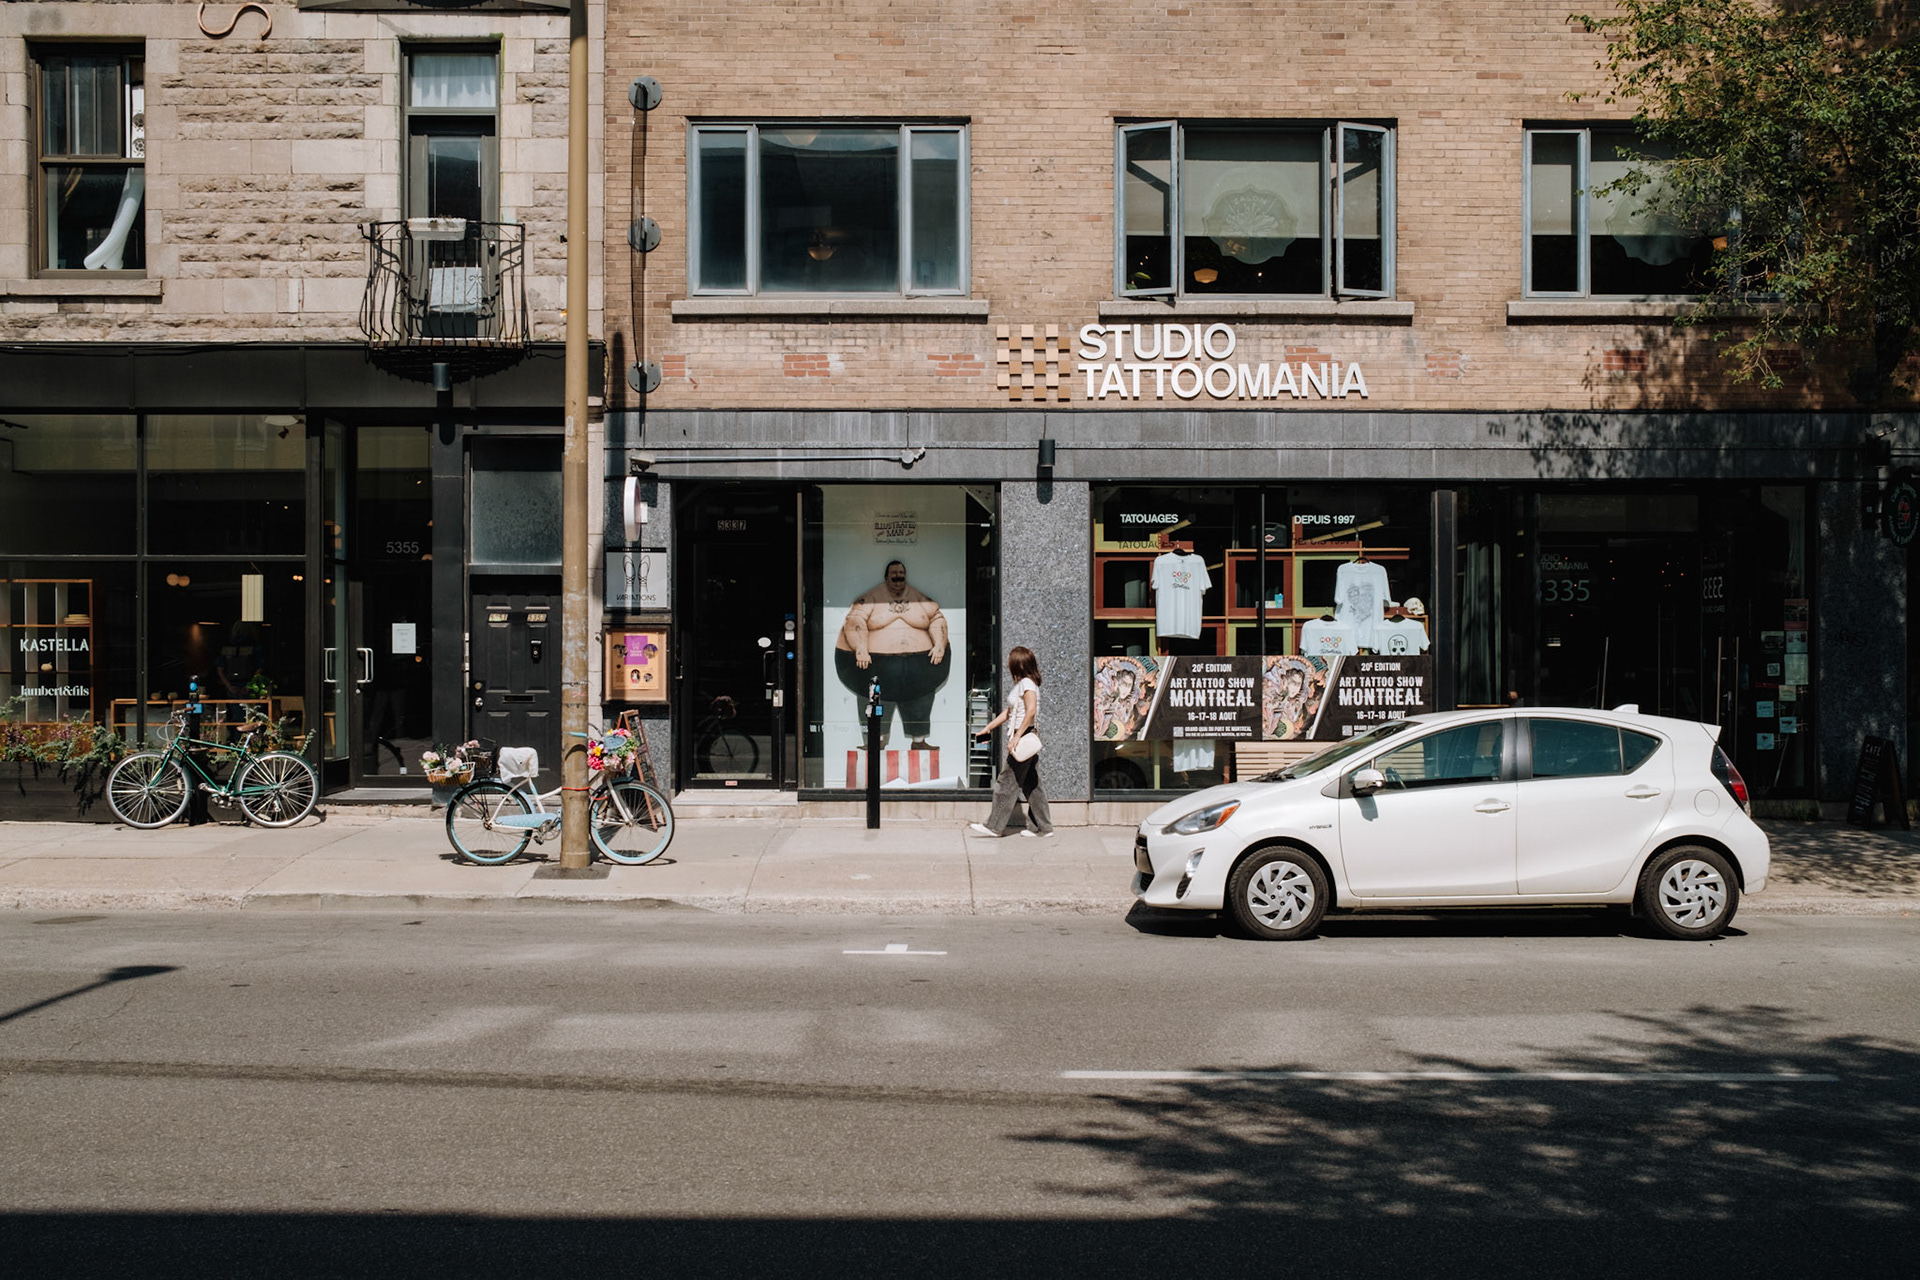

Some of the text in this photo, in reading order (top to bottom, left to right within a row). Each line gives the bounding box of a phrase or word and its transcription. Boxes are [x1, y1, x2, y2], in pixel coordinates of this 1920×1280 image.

[1078, 323, 1237, 360] STUDIO
[1077, 362, 1369, 399] TATTOOMANIA
[1120, 514, 1179, 524] TATOUAGES
[1294, 515, 1356, 525] DEPUIS 1997
[386, 541, 419, 554] 5355
[1541, 562, 1589, 570] TOOMANIA
[1544, 579, 1590, 602] 335
[20, 638, 89, 652] KASTELLA
[1205, 664, 1232, 673] EDITION
[1374, 662, 1401, 672] EDITION
[1170, 678, 1255, 688] ART TATTOO SHOW
[1339, 677, 1424, 687] ART TATTOO SHOW
[21, 685, 89, 697] lambert&fils
[1169, 689, 1256, 707] MONTREAL
[1338, 688, 1424, 706] MONTREAL
[1187, 712, 1237, 720] 16-17-18 AOUT
[1356, 710, 1406, 719] 16-17-18 AOUT
